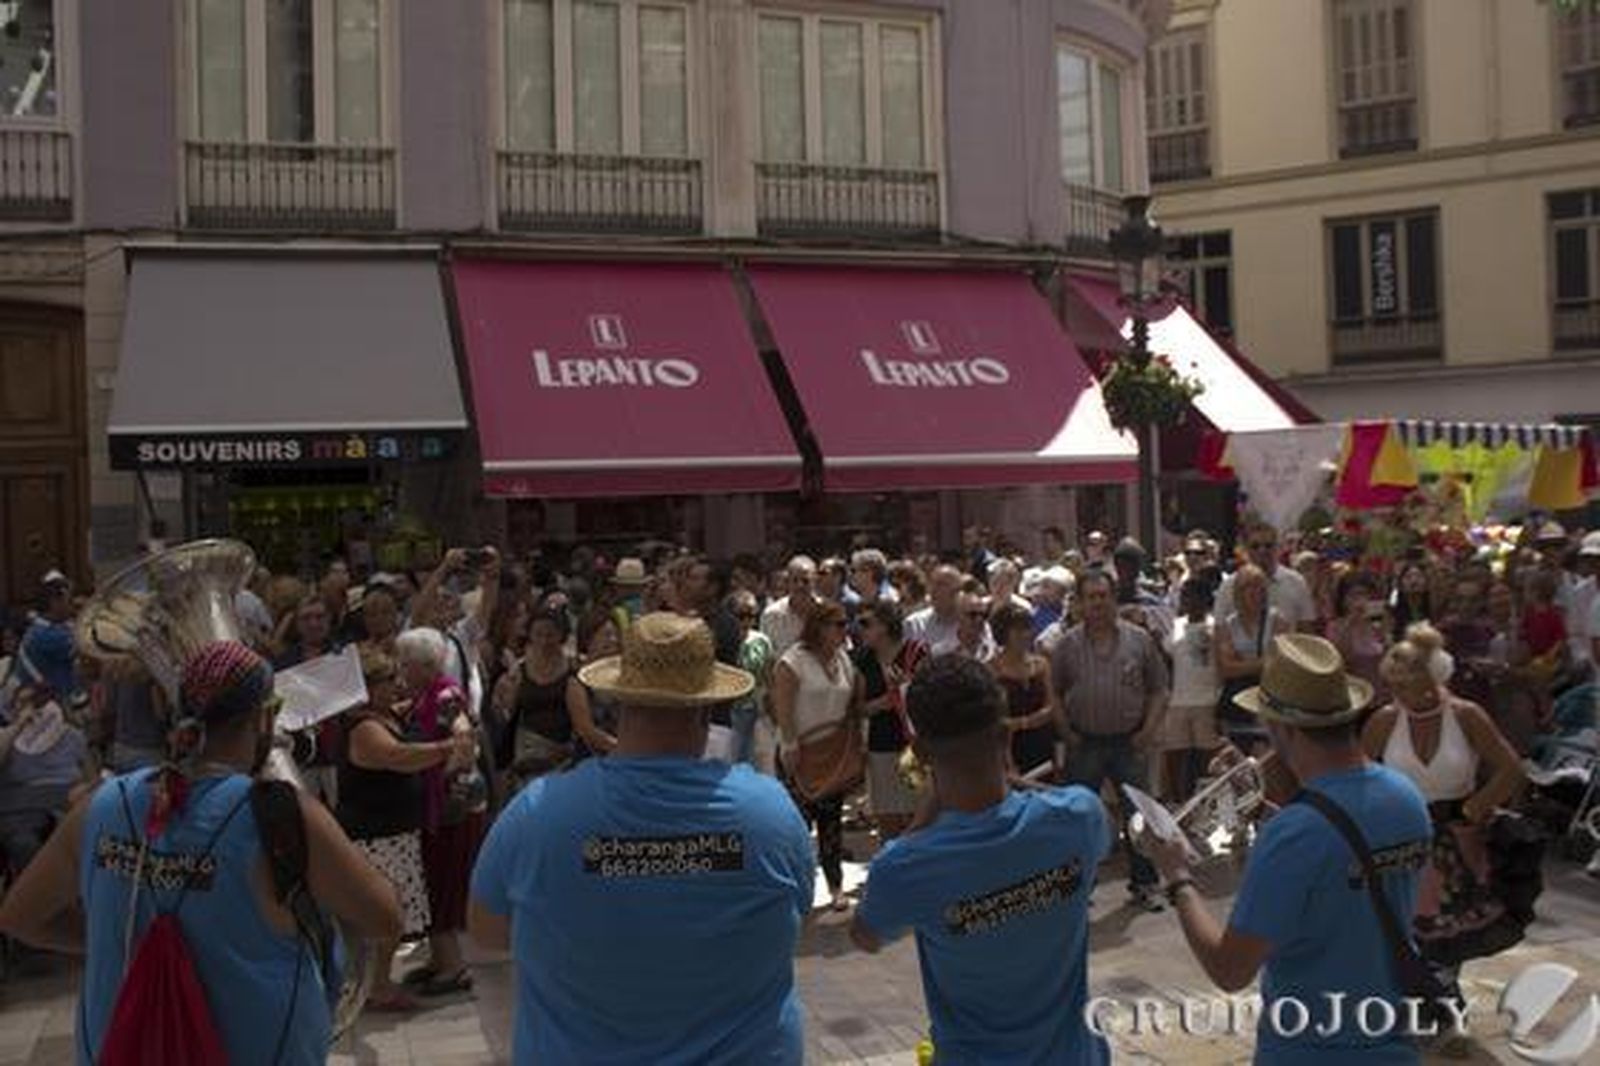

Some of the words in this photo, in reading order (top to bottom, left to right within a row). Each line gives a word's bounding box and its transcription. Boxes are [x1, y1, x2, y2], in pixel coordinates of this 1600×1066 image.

[532, 350, 699, 387] LEPANTO
[861, 349, 1009, 386] LEPANTO
[137, 439, 301, 462] SOUVENIRS
